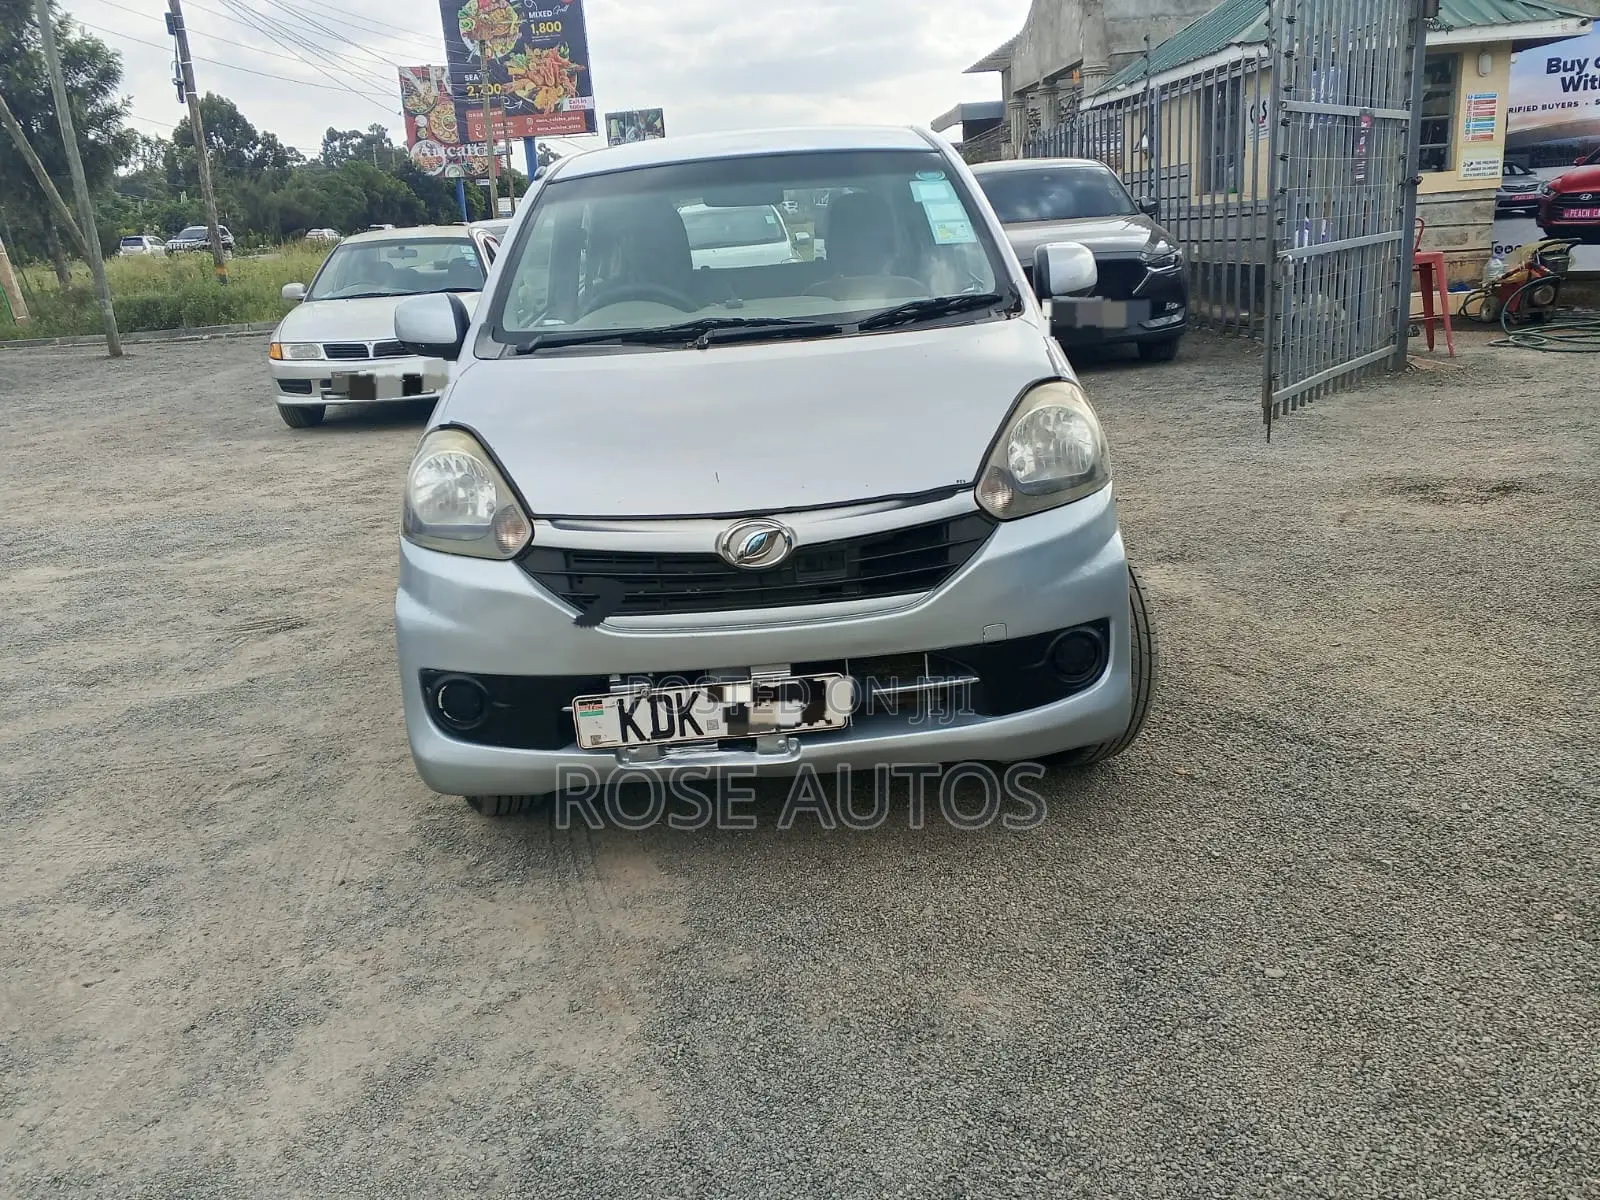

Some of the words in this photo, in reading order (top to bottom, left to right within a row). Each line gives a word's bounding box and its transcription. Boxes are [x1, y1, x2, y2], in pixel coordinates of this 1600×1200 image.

[528, 10, 552, 18] MIXED
[530, 20, 562, 36] 1,800
[1546, 57, 1589, 75] Buy
[1560, 73, 1600, 92] Wit
[1508, 105, 1538, 114] RIFIED
[1542, 101, 1579, 110] BUYERS
[1570, 208, 1590, 218] PEACH
[617, 690, 704, 742] KDK
